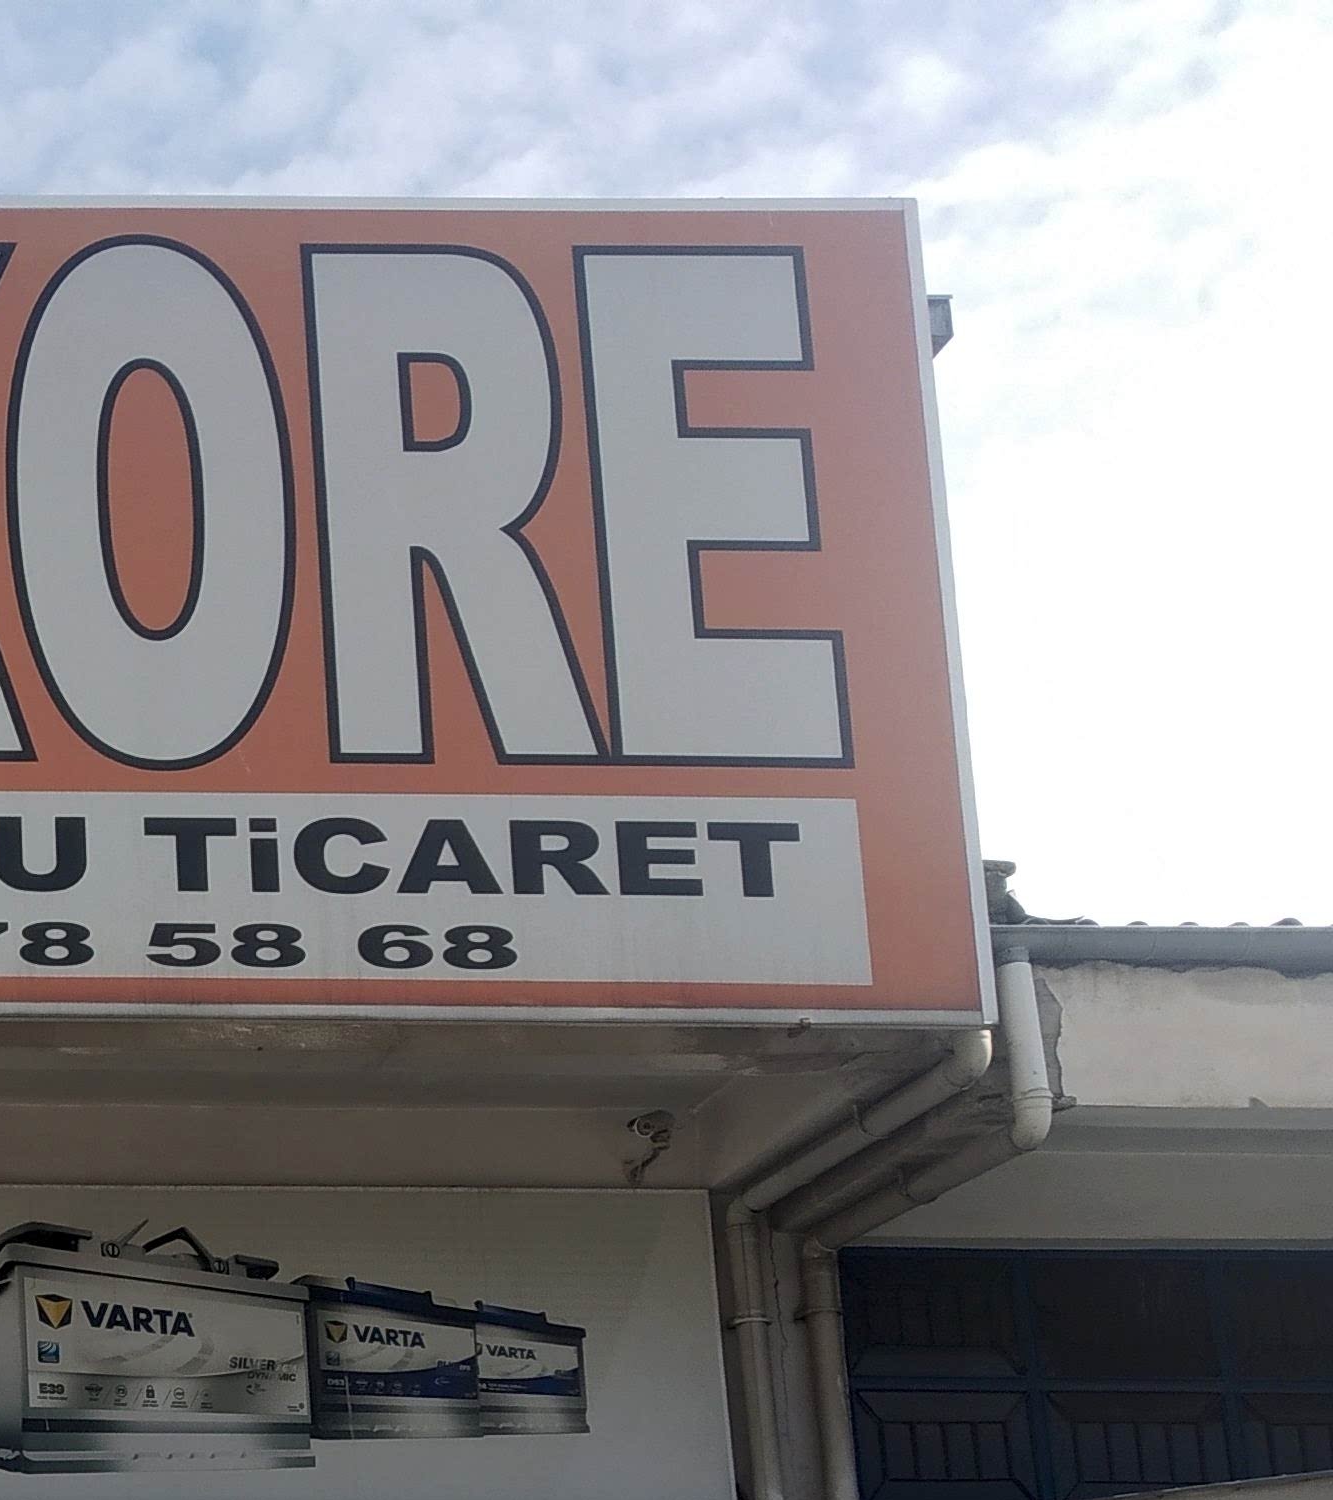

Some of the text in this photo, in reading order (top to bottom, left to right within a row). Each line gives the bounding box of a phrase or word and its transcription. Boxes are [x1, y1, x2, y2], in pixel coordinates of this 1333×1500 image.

[147, 922, 305, 969] 58
[356, 923, 519, 970] 68
[81, 1300, 195, 1337] VARTA
[352, 1324, 426, 1349] VARTA
[486, 1343, 536, 1361] VARTA
